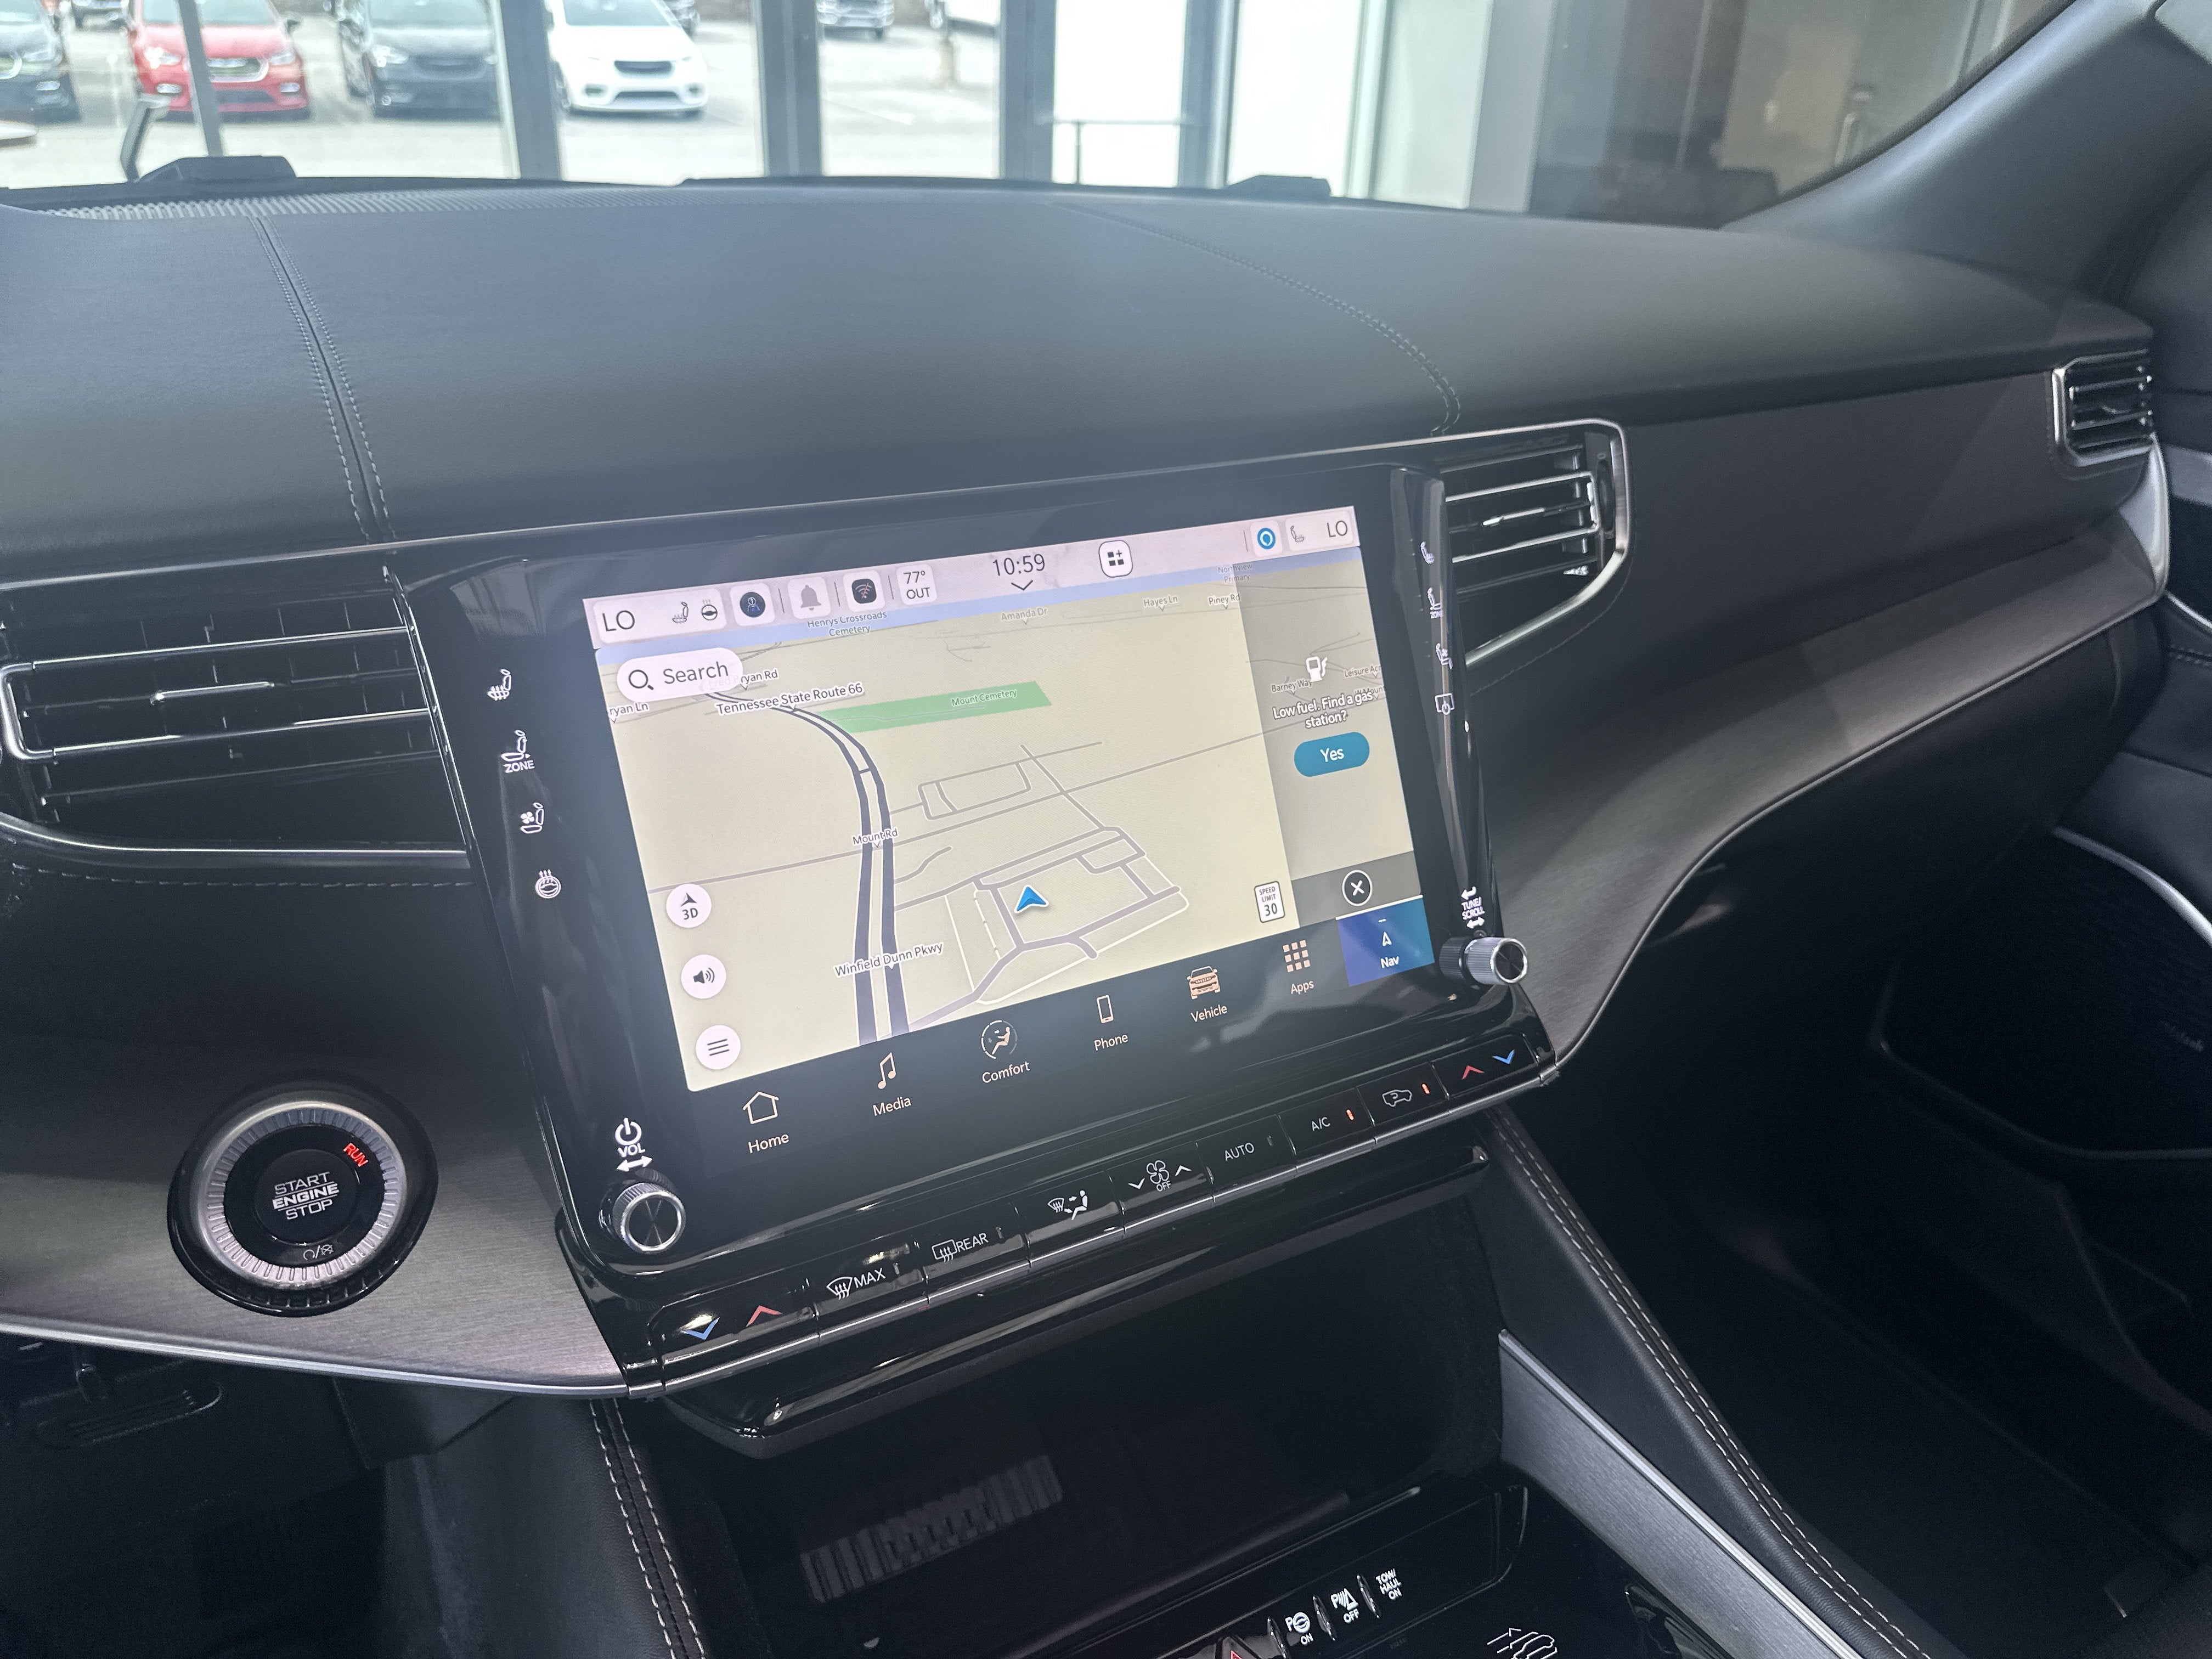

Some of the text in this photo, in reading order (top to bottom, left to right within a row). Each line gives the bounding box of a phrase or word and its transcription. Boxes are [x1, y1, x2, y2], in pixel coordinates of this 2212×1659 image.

[1326, 521, 1348, 538] LO
[992, 554, 1046, 577] 10:59
[904, 570, 926, 584] 77°
[1224, 574, 1250, 583] Primary
[906, 587, 930, 600] OUT
[1209, 593, 1240, 605] Piney Rd
[1143, 597, 1168, 607] Hayes
[602, 610, 635, 632] LO
[807, 611, 887, 628] Henrys Crossroads
[1001, 607, 1047, 620] Amanda Dr
[829, 625, 870, 637] Cemetery
[663, 661, 729, 685] Search
[764, 669, 778, 680] Rd
[1344, 668, 1369, 678] Leisure
[1271, 680, 1312, 693] Barney Way
[717, 683, 863, 715] Tennessee State Route 66
[951, 690, 1017, 706] Mount Cemetery
[1272, 691, 1374, 719] Low fuel. Find a gas
[636, 702, 648, 712] Ln
[1305, 709, 1348, 729] station?
[1320, 748, 1344, 762] Yes
[503, 760, 535, 774] ZONE
[853, 829, 898, 845] Mount Rd
[1259, 886, 1276, 895] SPEED
[1262, 894, 1276, 902] LIMIT
[682, 907, 698, 920] 3D
[1264, 903, 1277, 916] 30
[1462, 906, 1485, 920] SCROLL
[835, 943, 943, 977] Winfield Dunn Pkwy
[1380, 955, 1400, 969] Nav
[1290, 980, 1314, 995] Apps
[1190, 1004, 1228, 1023] Vehicle
[1093, 1033, 1128, 1051] Phone
[981, 1061, 1031, 1084] Comfort
[872, 1096, 912, 1118] Media
[1311, 1116, 1331, 1132] A/C
[617, 1143, 646, 1158] VOL
[748, 1132, 790, 1154] Home
[342, 1142, 369, 1167] RUN
[1224, 1142, 1255, 1162] AUTO
[274, 1171, 330, 1195] START
[1156, 1180, 1172, 1192] OFF
[272, 1183, 340, 1210] ENGINE
[285, 1199, 333, 1220] STOP
[956, 1232, 989, 1252] REAR
[854, 1267, 886, 1288] MAX
[1379, 1578, 1402, 1595] HAUL
[1388, 1588, 1402, 1600] ON
[1344, 1608, 1360, 1624] OFF
[1300, 1633, 1313, 1645] ON
